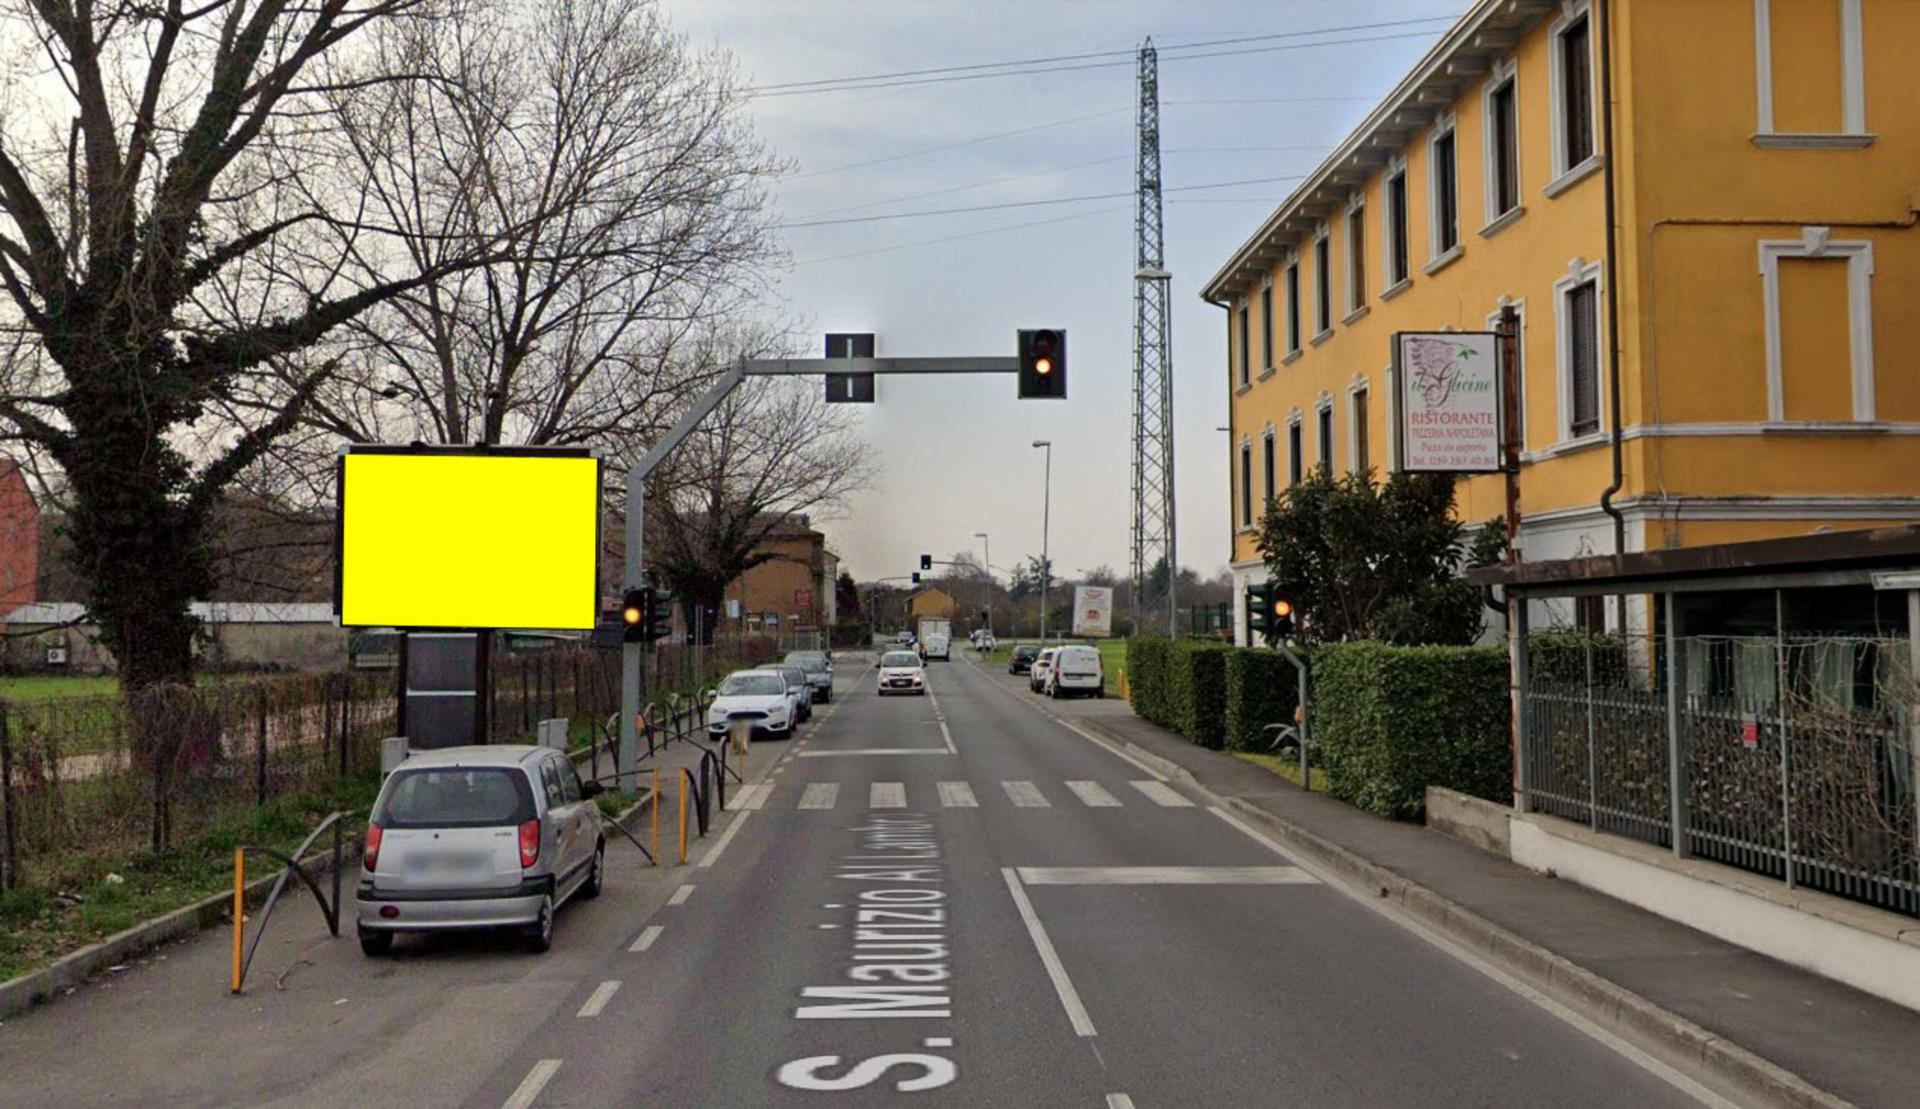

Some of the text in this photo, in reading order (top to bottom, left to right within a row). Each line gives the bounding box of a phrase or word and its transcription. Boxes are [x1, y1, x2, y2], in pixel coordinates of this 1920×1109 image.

[1424, 361, 1492, 407] Glicine
[1411, 427, 1495, 438] PIZZERIA NAPOLETANA
[1412, 412, 1494, 425] RISTORANTE
[796, 889, 950, 1019] Maurizio
[778, 1037, 957, 1091] S.
